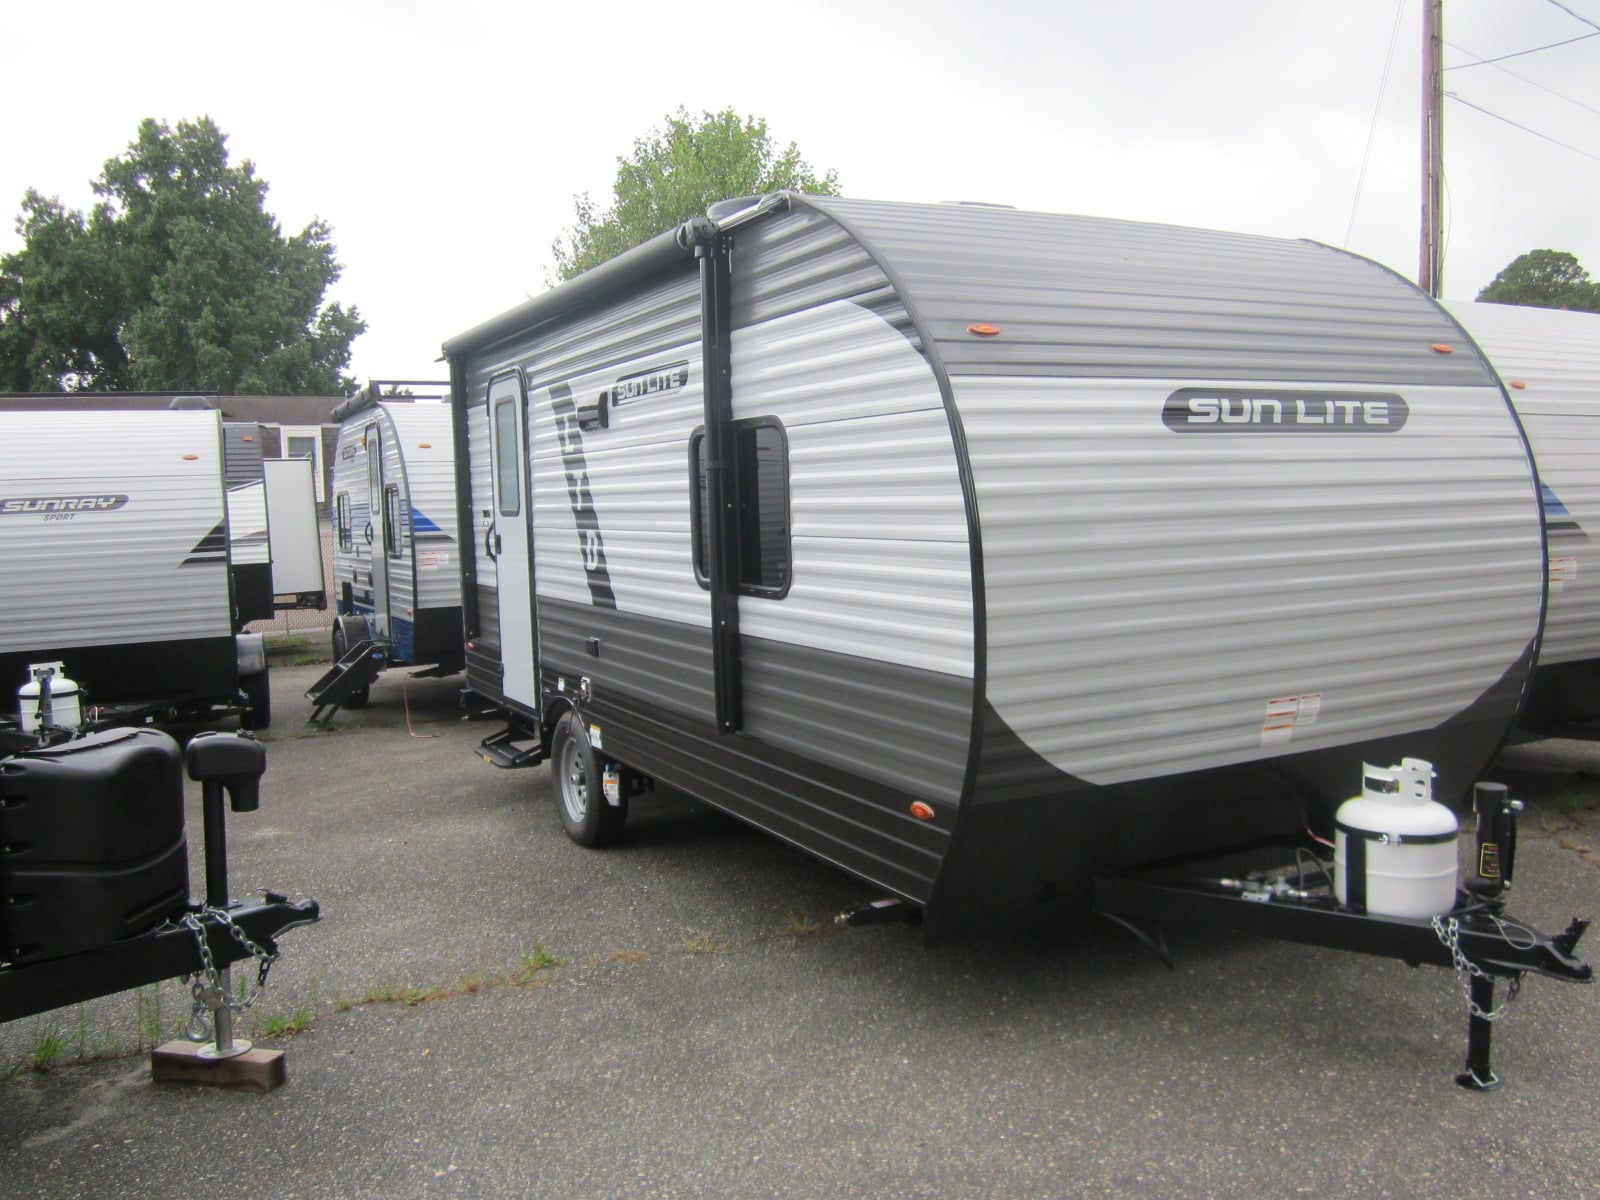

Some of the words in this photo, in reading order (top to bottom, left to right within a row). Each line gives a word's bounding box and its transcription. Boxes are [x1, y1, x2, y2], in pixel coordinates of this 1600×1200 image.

[617, 379, 644, 400] SUN
[647, 369, 680, 394] LITE
[1187, 398, 1282, 424] SUN
[1296, 399, 1389, 425] LITE
[2, 497, 116, 512] SUNRAY
[43, 513, 76, 522] SPORT
